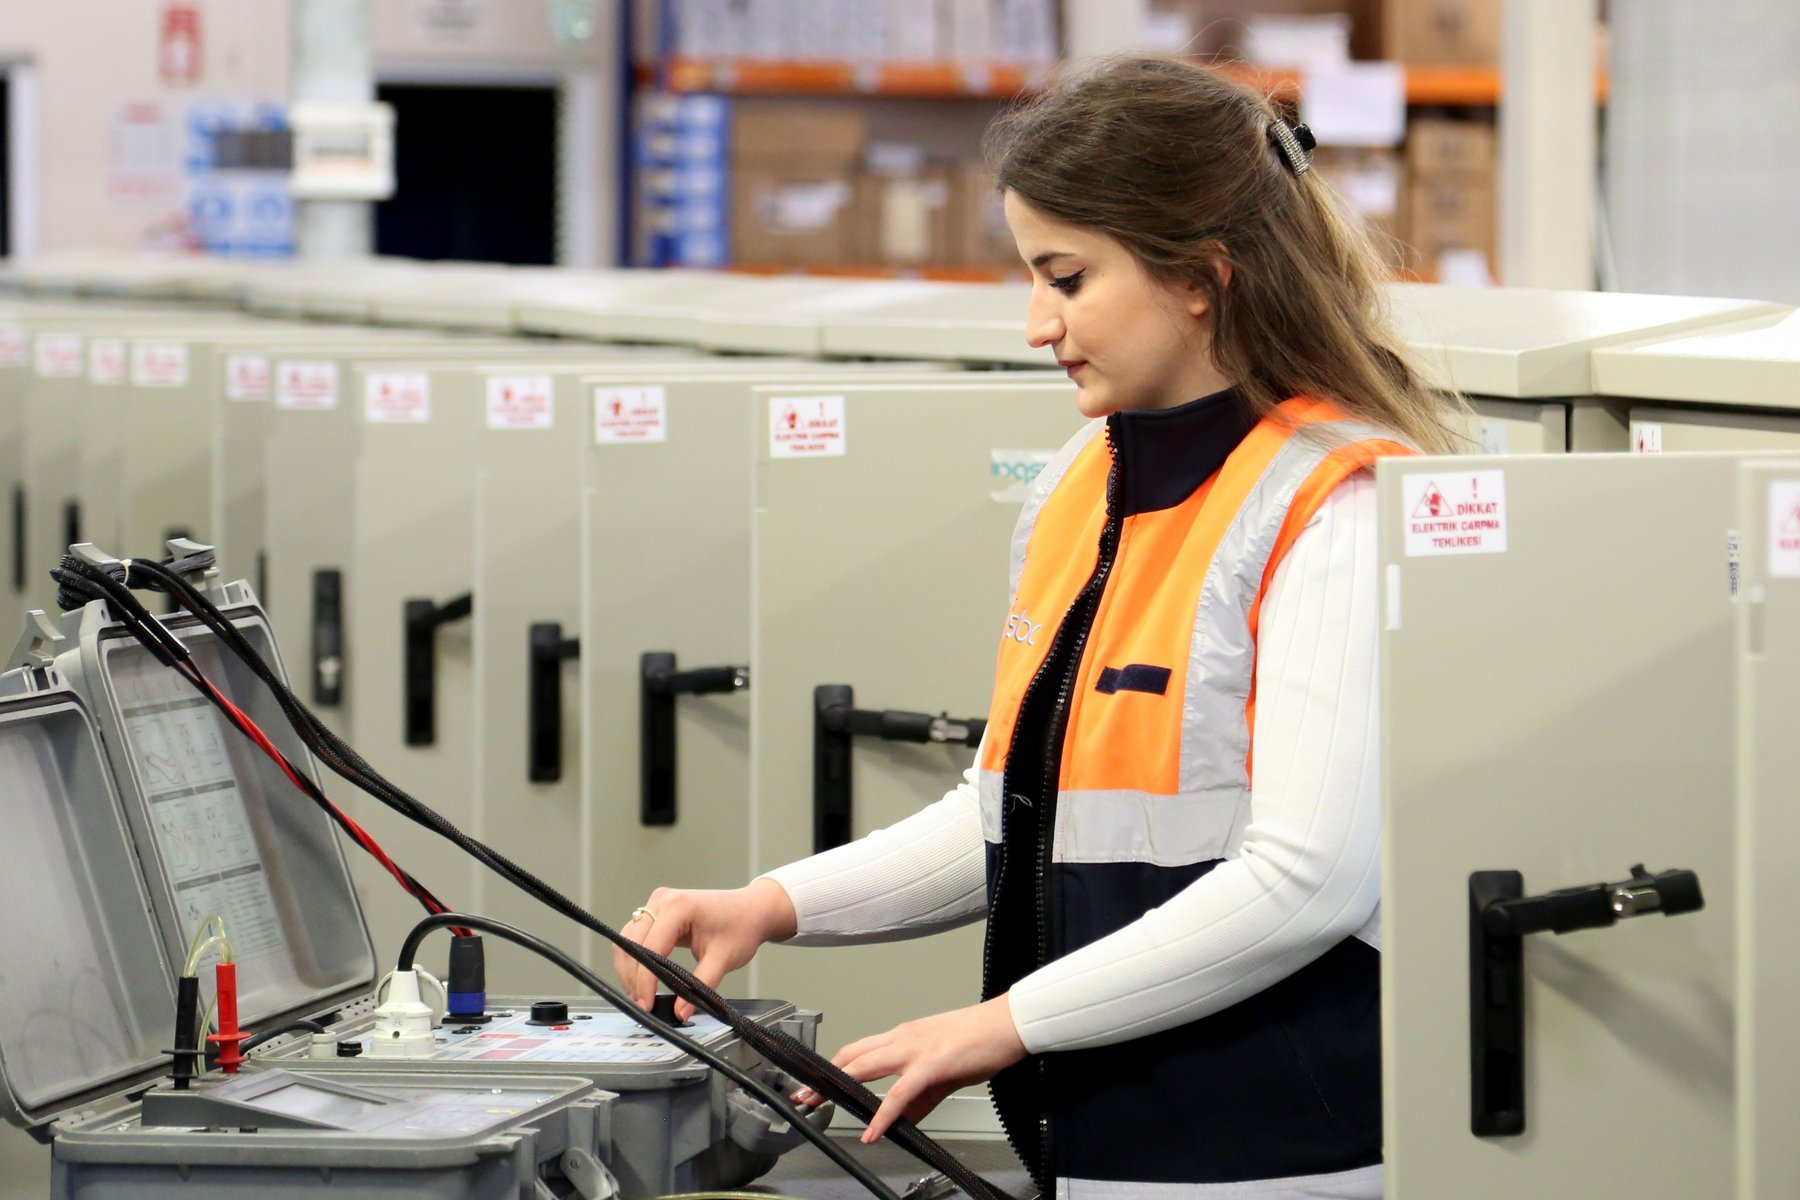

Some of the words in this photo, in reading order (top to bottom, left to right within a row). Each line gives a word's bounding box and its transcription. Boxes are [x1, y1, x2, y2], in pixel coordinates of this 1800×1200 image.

[1457, 502, 1498, 516] DİKKAT
[1411, 521, 1457, 534] ELEKTRİK
[1432, 536, 1482, 549] TEHLİKESİ
